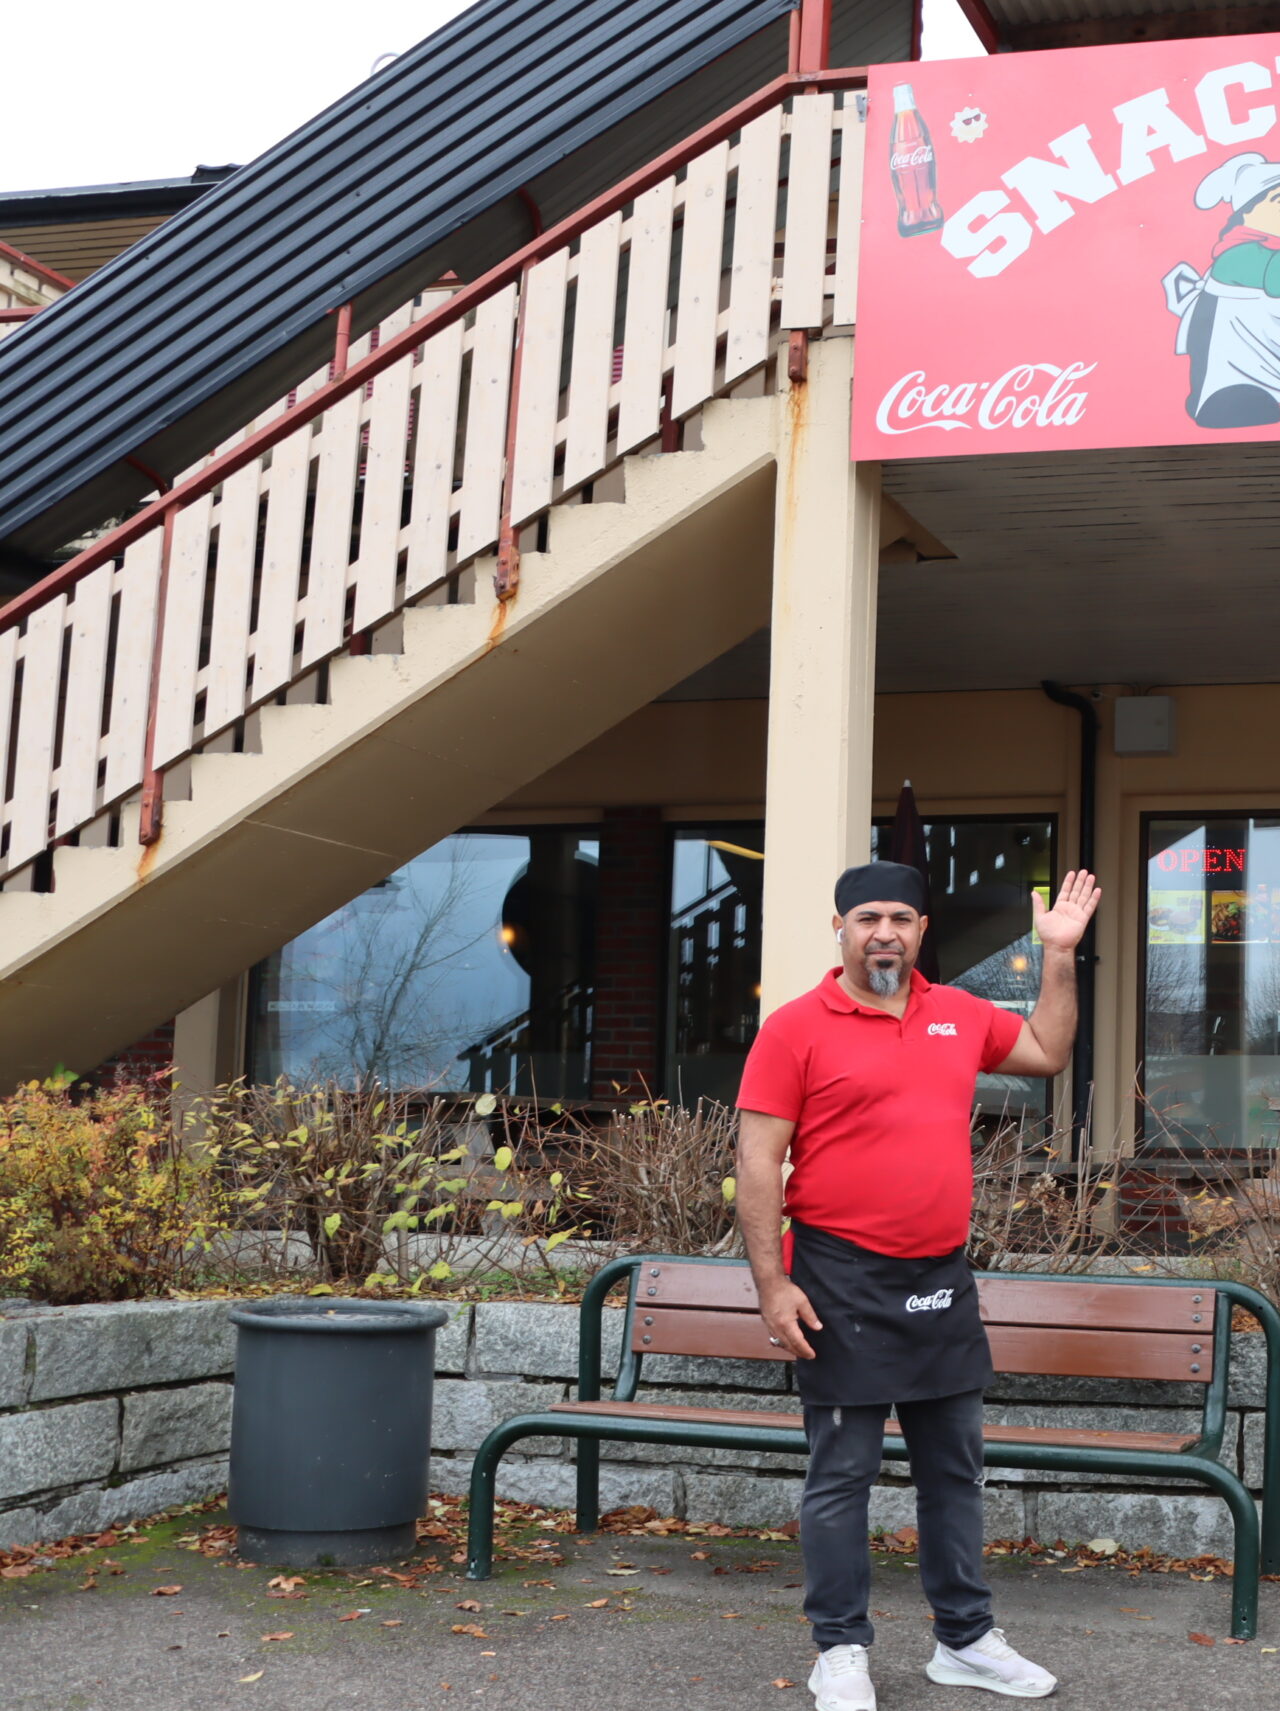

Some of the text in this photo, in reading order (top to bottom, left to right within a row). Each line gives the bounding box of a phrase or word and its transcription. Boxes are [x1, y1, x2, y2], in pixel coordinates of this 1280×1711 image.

[890, 145, 933, 170] Coca-Cola
[876, 361, 1097, 434] Coca-Cola
[1157, 848, 1246, 872] OPEN
[927, 1022, 958, 1036] Coca-Cola
[905, 1288, 954, 1312] Coca-Cola
